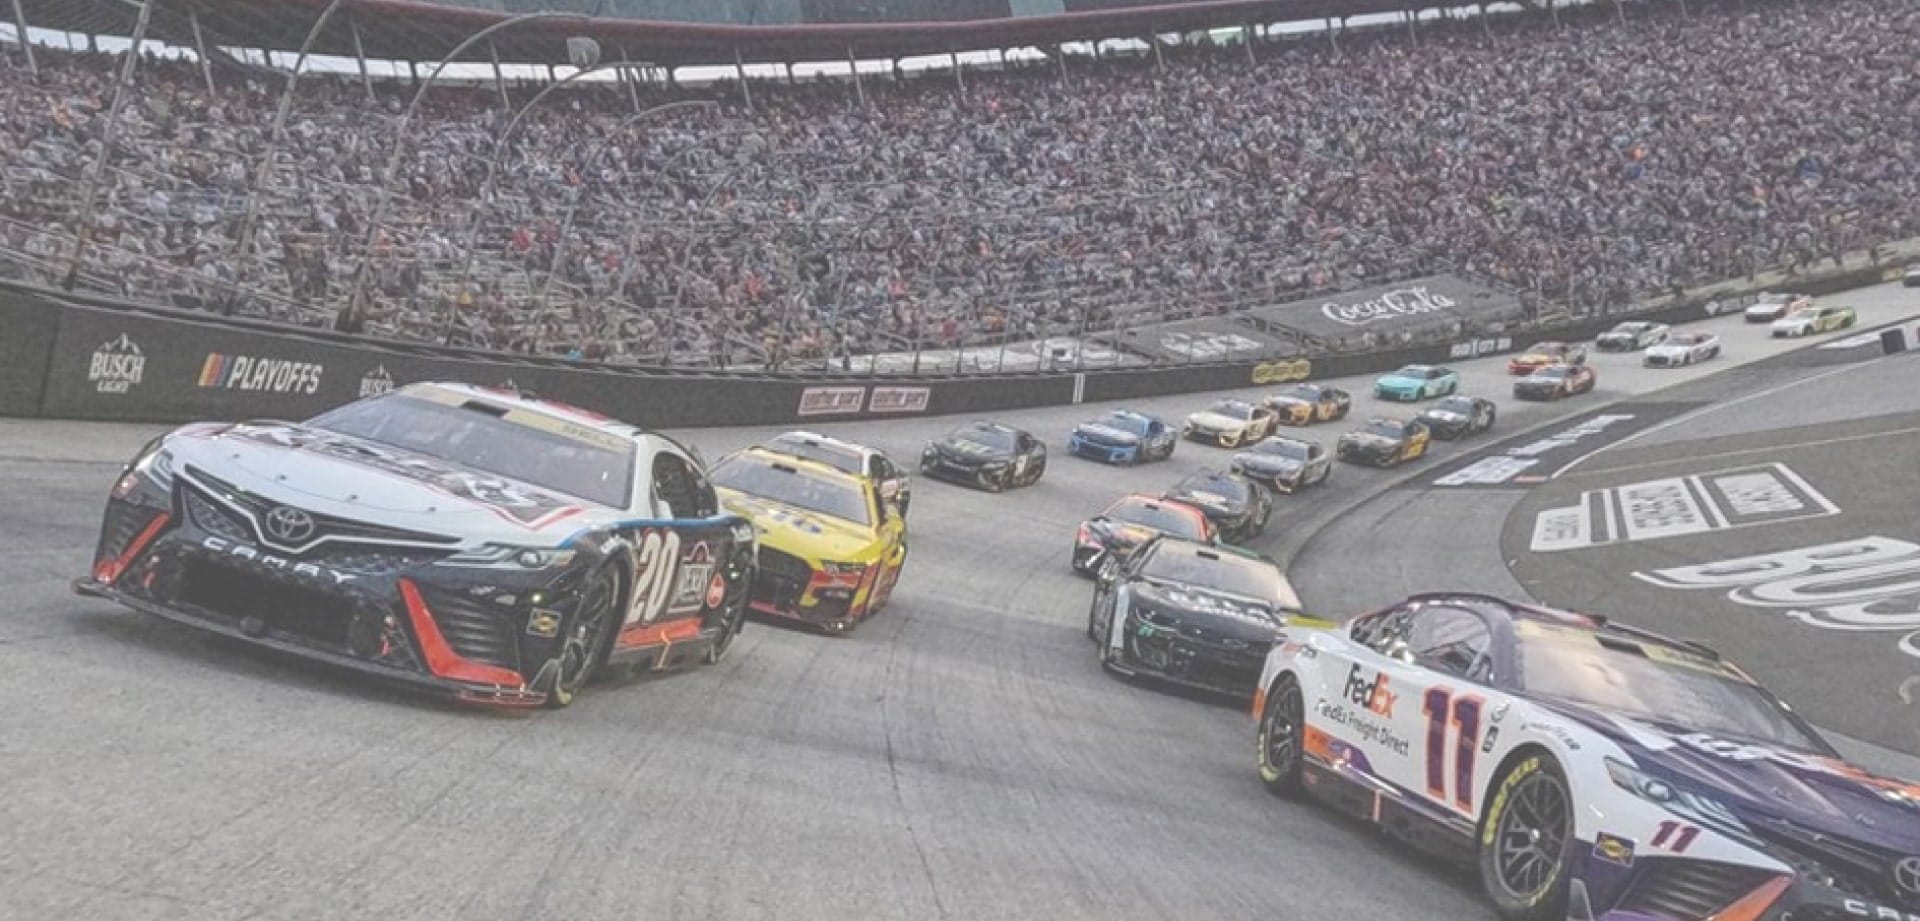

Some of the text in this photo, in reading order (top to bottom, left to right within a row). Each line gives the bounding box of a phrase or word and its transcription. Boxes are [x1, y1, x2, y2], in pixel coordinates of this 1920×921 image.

[89, 352, 145, 384] BUSCH
[226, 356, 323, 394] PLAYOFFS
[359, 377, 395, 397] BUSCH
[202, 536, 357, 584] CAMRY
[623, 528, 680, 625] 20
[1343, 662, 1398, 719] FedEx
[1422, 684, 1486, 815] 11
[1649, 819, 1702, 854] 11
